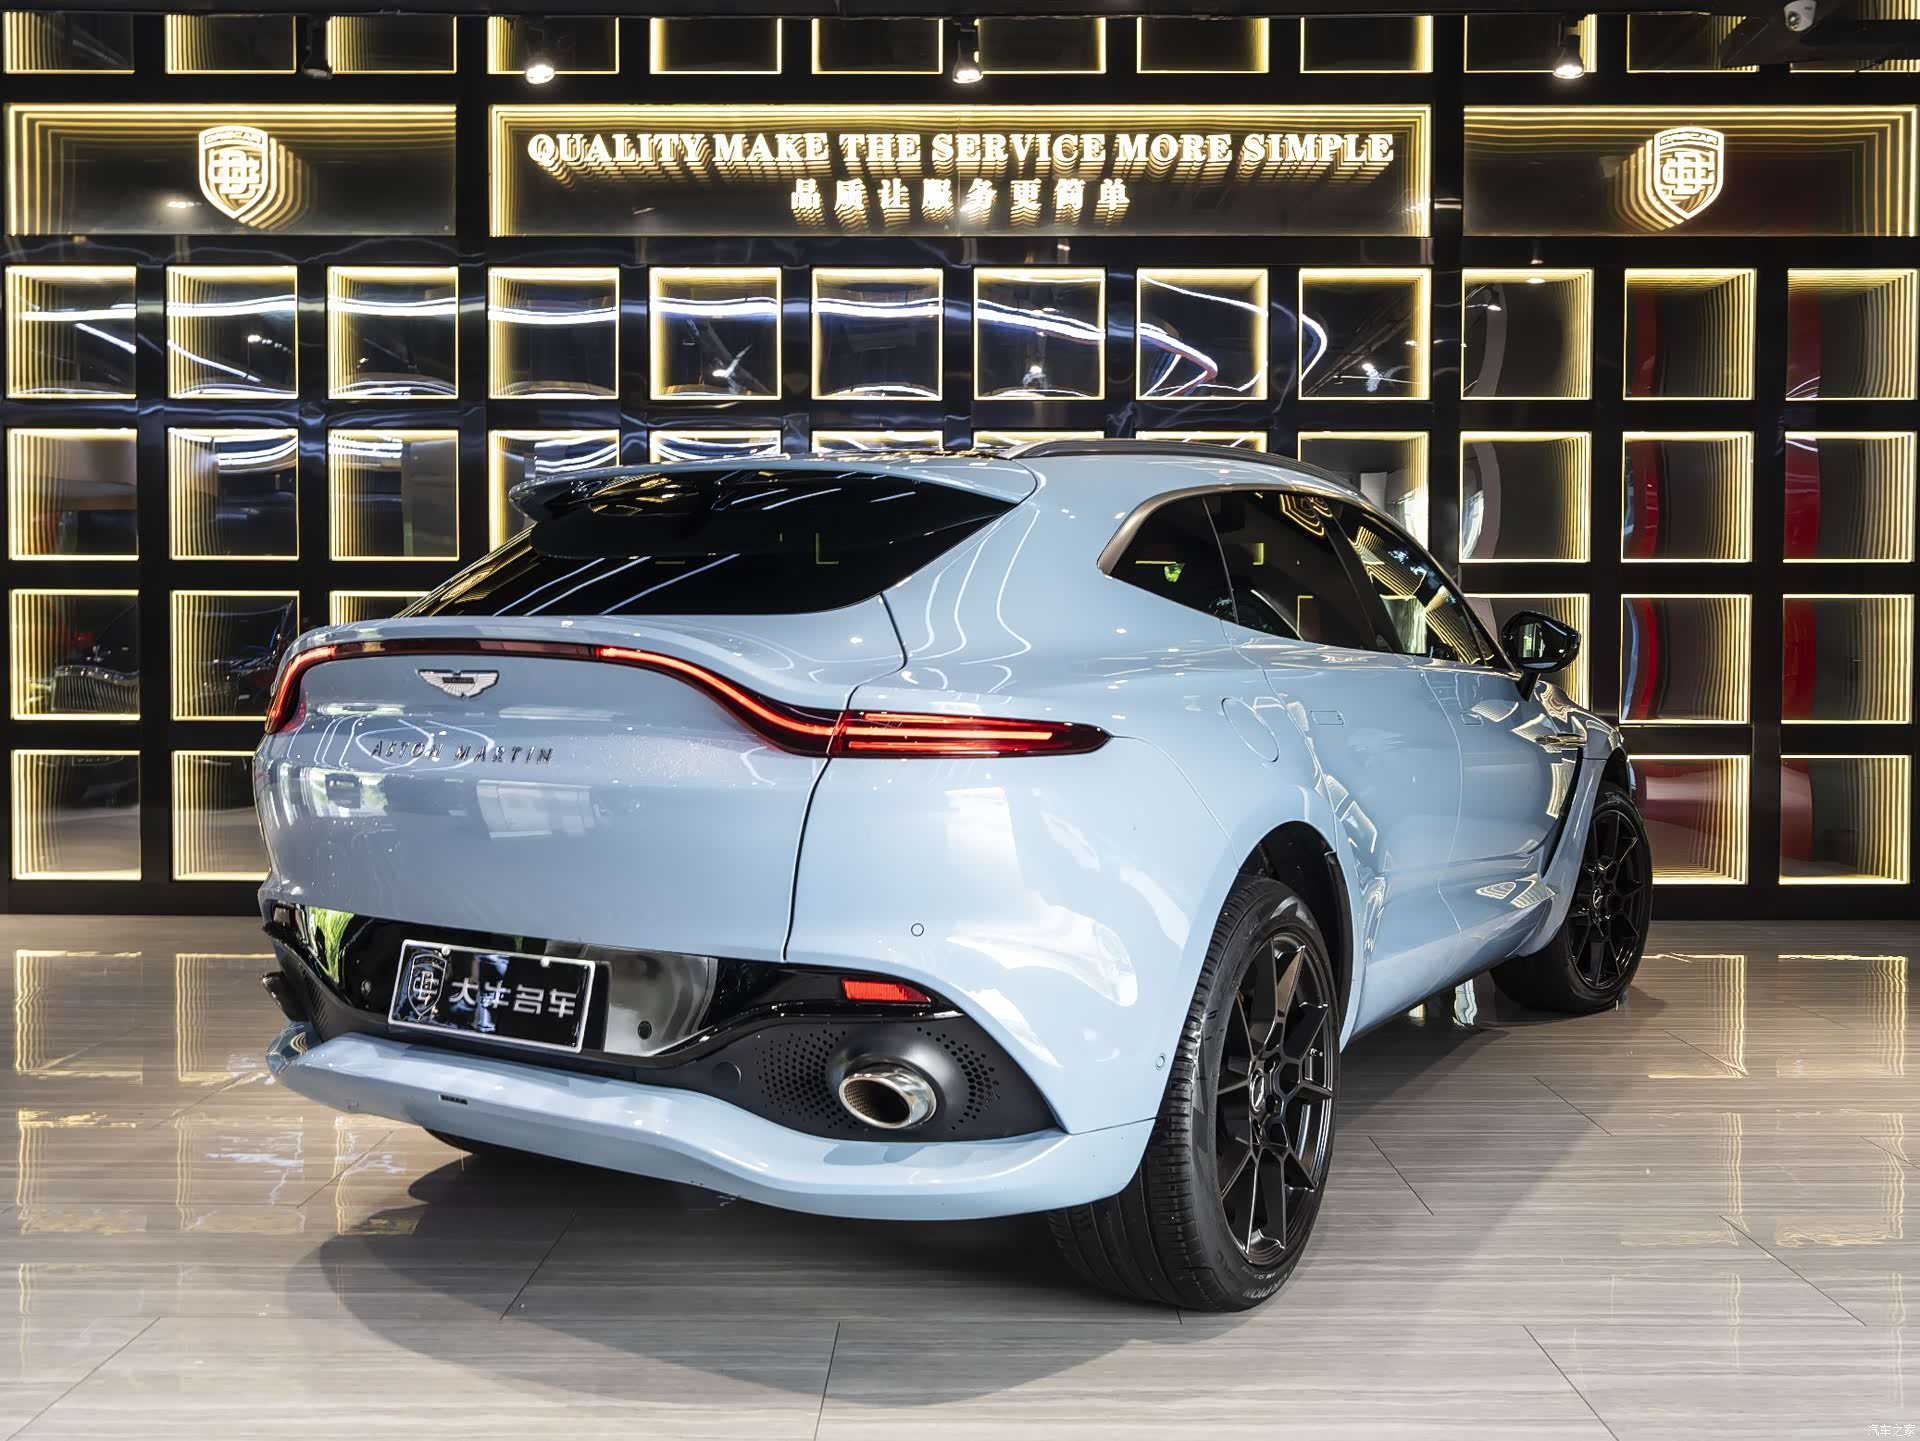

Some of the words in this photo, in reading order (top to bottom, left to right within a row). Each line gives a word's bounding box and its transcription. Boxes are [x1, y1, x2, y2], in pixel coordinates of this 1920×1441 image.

[527, 133, 705, 165] QUALITY
[712, 133, 828, 162] MAKE
[839, 134, 921, 162] THE
[931, 133, 1106, 162] SERVICE
[1117, 133, 1232, 162] MORE
[1243, 133, 1394, 162] SIMPLE
[791, 178, 1130, 210] 品质让服务更简单
[371, 740, 443, 758] ASTON
[454, 744, 554, 764] MARTIN
